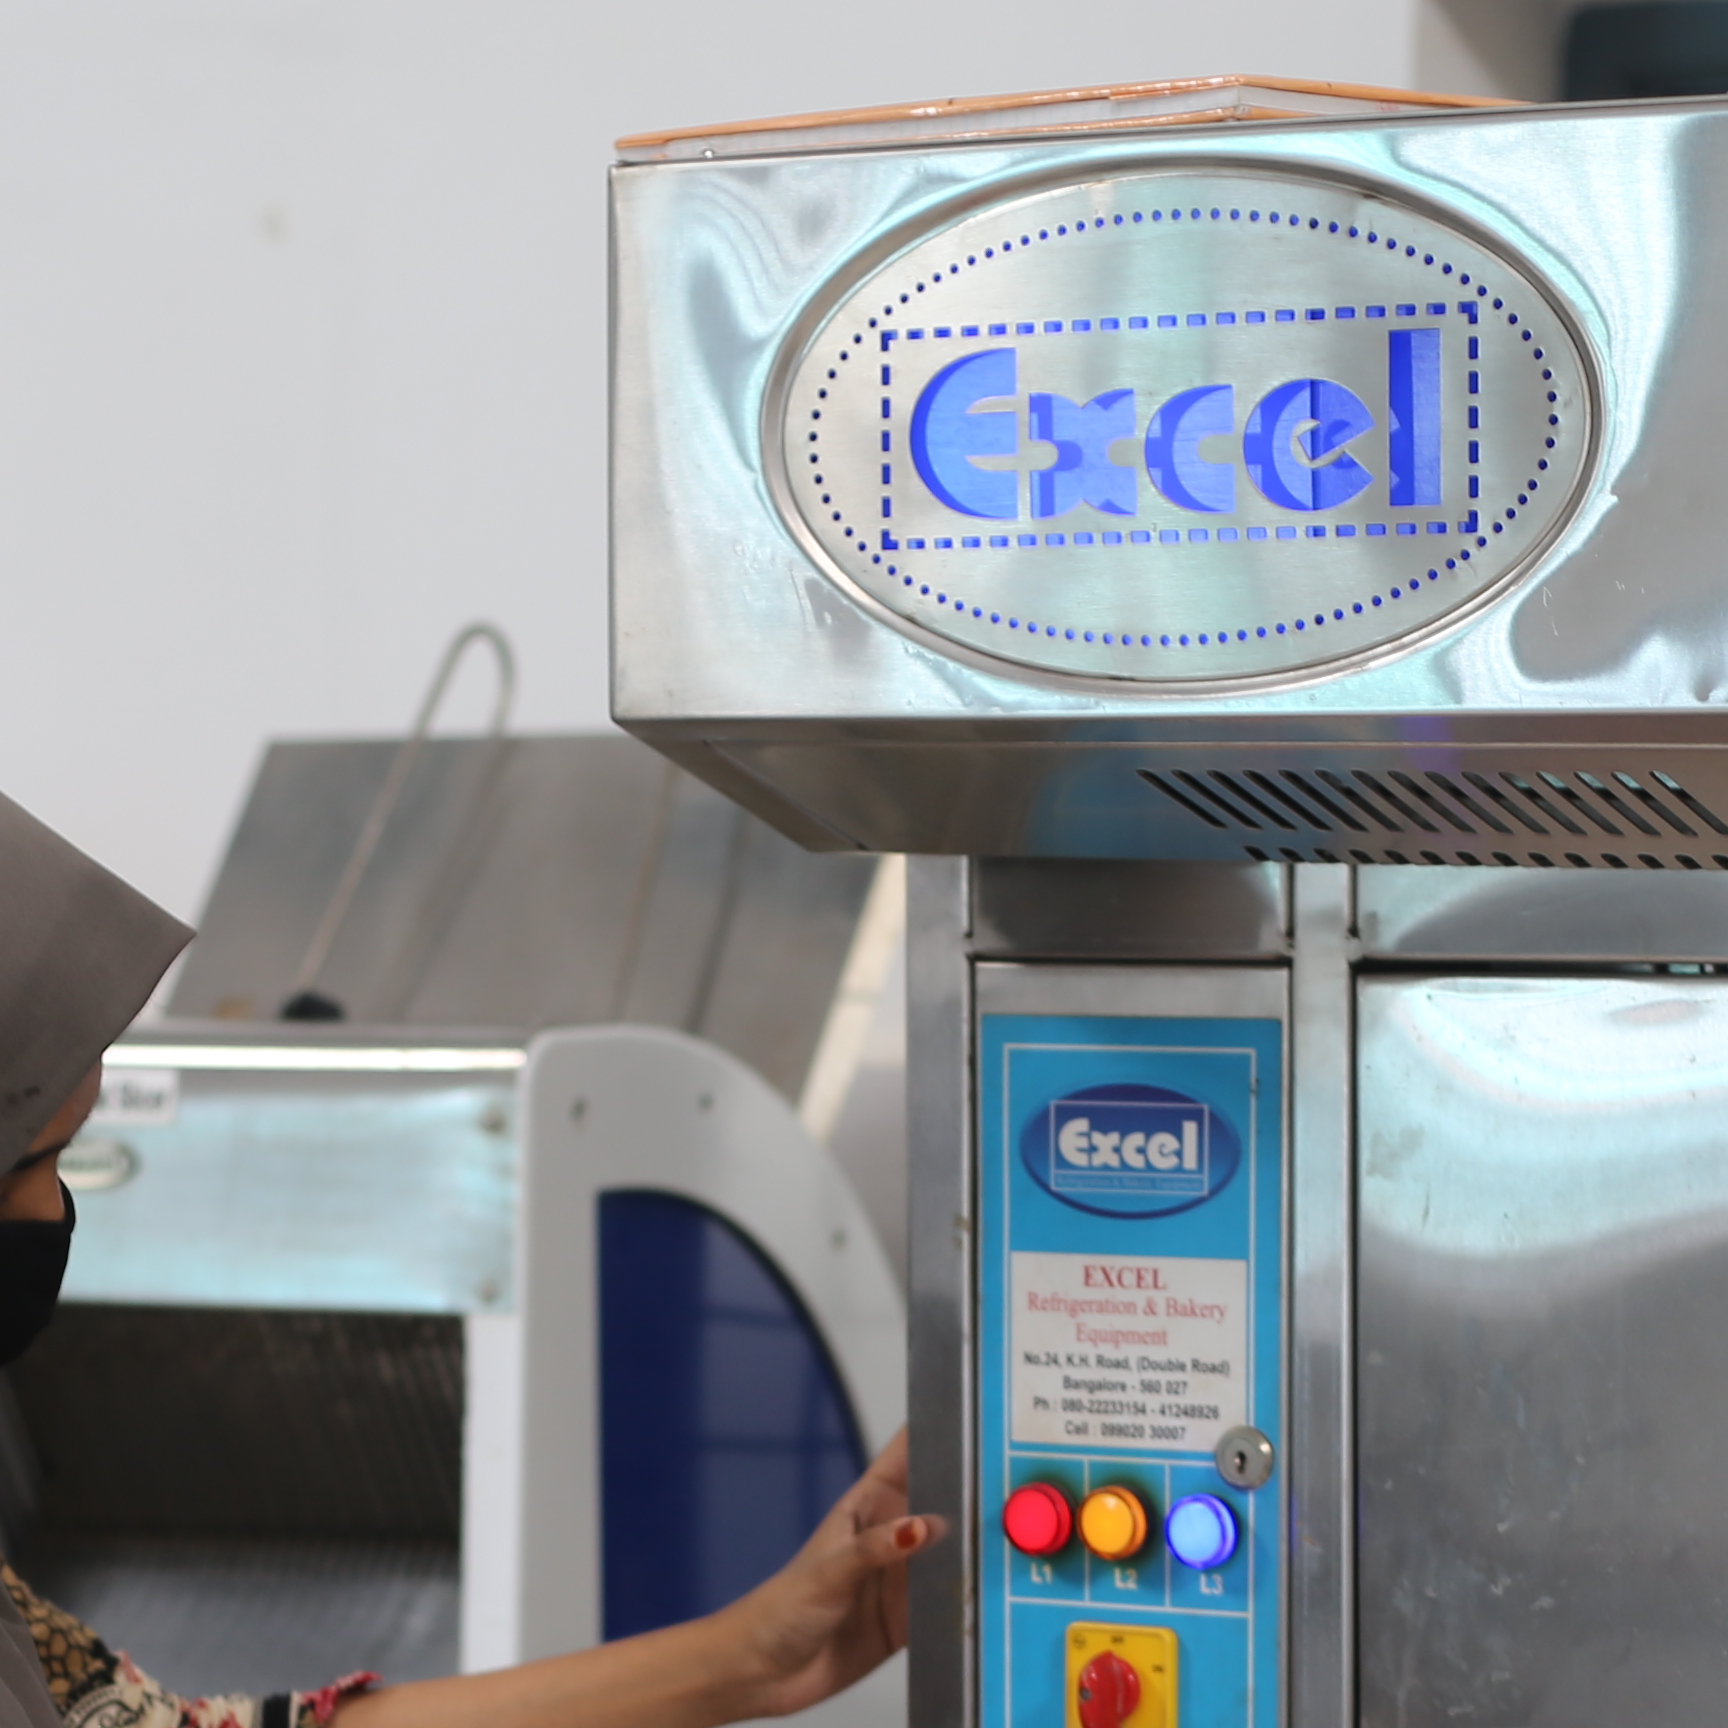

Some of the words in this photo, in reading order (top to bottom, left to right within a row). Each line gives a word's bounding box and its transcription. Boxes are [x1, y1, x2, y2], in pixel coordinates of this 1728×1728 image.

[909, 328, 1442, 520] Excel
[1058, 1116, 1199, 1171] Excel
[1083, 1265, 1167, 1290] EXCEL
[1027, 1291, 1137, 1318] Refrigeration
[1143, 1298, 1158, 1316] &
[1166, 1297, 1228, 1323] Bakery
[1076, 1323, 1168, 1348] Equipment
[1137, 1357, 1187, 1374] (Double
[1191, 1359, 1230, 1377] Road)
[1063, 1375, 1127, 1394] Bangalore
[1031, 1564, 1052, 1583] L1
[1114, 1569, 1137, 1589] L2
[1200, 1574, 1224, 1595] L3
